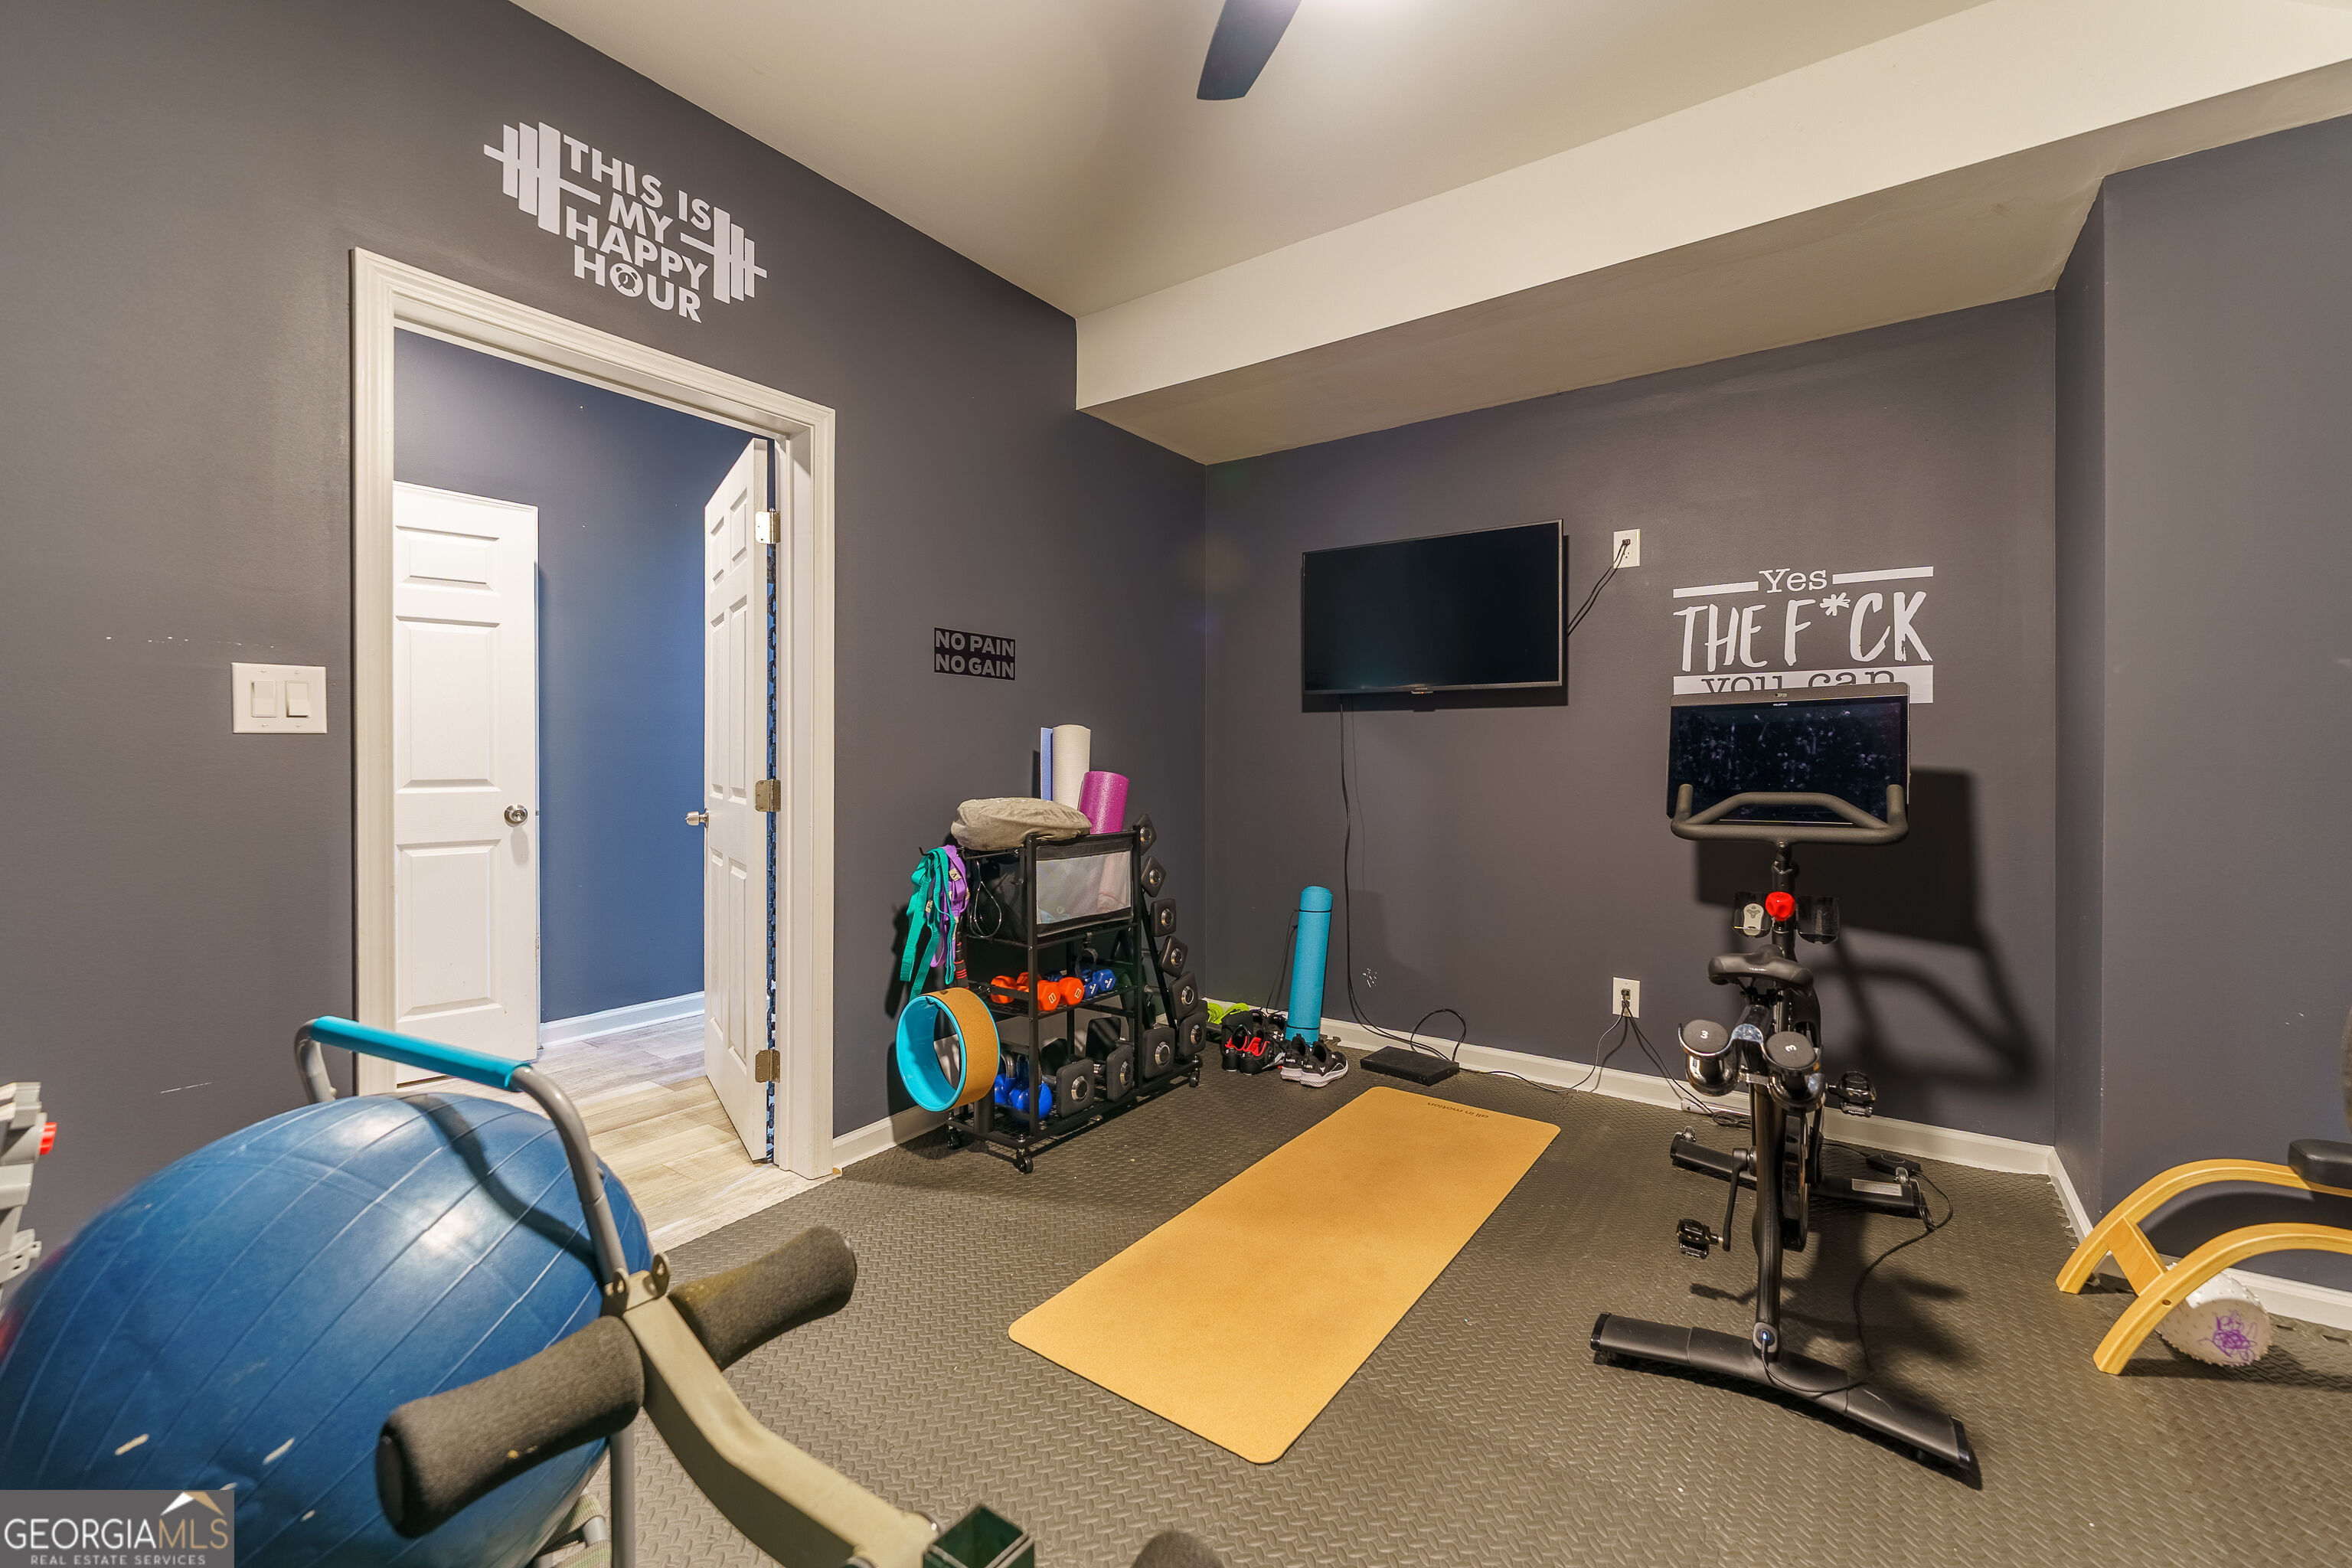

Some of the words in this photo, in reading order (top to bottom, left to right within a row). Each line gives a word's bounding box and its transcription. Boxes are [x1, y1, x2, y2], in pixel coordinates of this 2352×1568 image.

[563, 133, 664, 208] THIS
[678, 189, 712, 231] IS
[609, 191, 674, 244] MY
[566, 204, 709, 291] HAPPY
[573, 244, 702, 324] HOUR
[1758, 567, 1828, 594] Yes
[936, 630, 965, 651] NO
[970, 635, 1014, 657] PAIN
[1673, 603, 1768, 672] THE
[936, 653, 965, 673] NO
[969, 657, 1014, 678] GAIN
[1700, 1030, 1709, 1040] 3
[1427, 1102, 1463, 1112] motion
